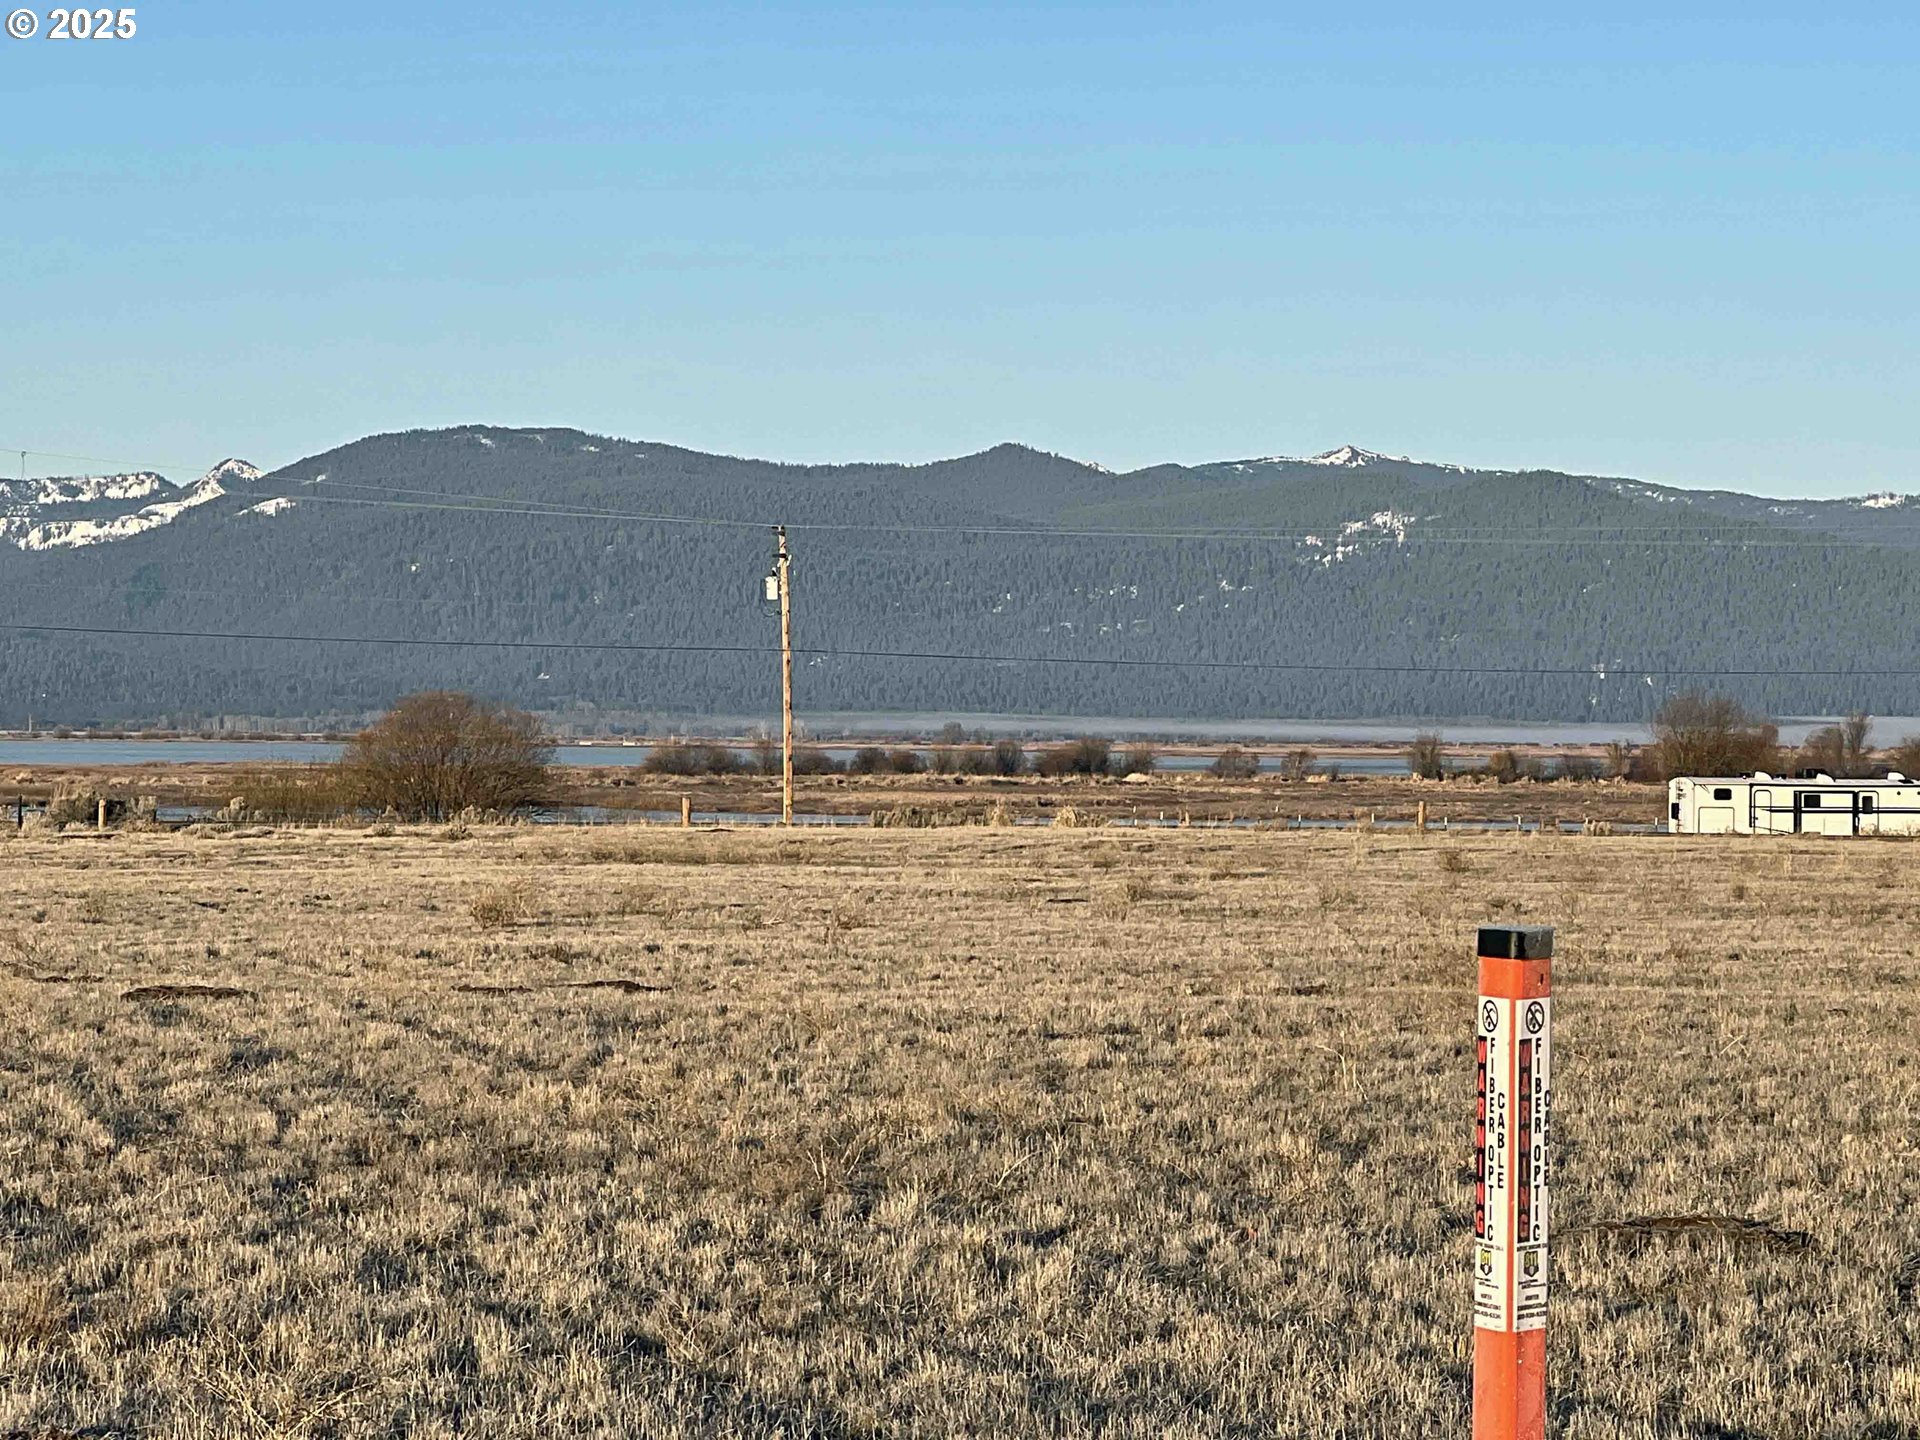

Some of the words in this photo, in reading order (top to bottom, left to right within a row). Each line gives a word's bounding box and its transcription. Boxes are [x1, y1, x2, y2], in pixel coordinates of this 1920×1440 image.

[1488, 1037, 1496, 1134] FIBER
[1534, 1037, 1542, 1134] FIBER
[1477, 1040, 1487, 1234] WARNING
[1497, 1092, 1505, 1189] CABLE
[1520, 1043, 1531, 1238] WARNING
[1533, 1144, 1541, 1241] OPTIC
